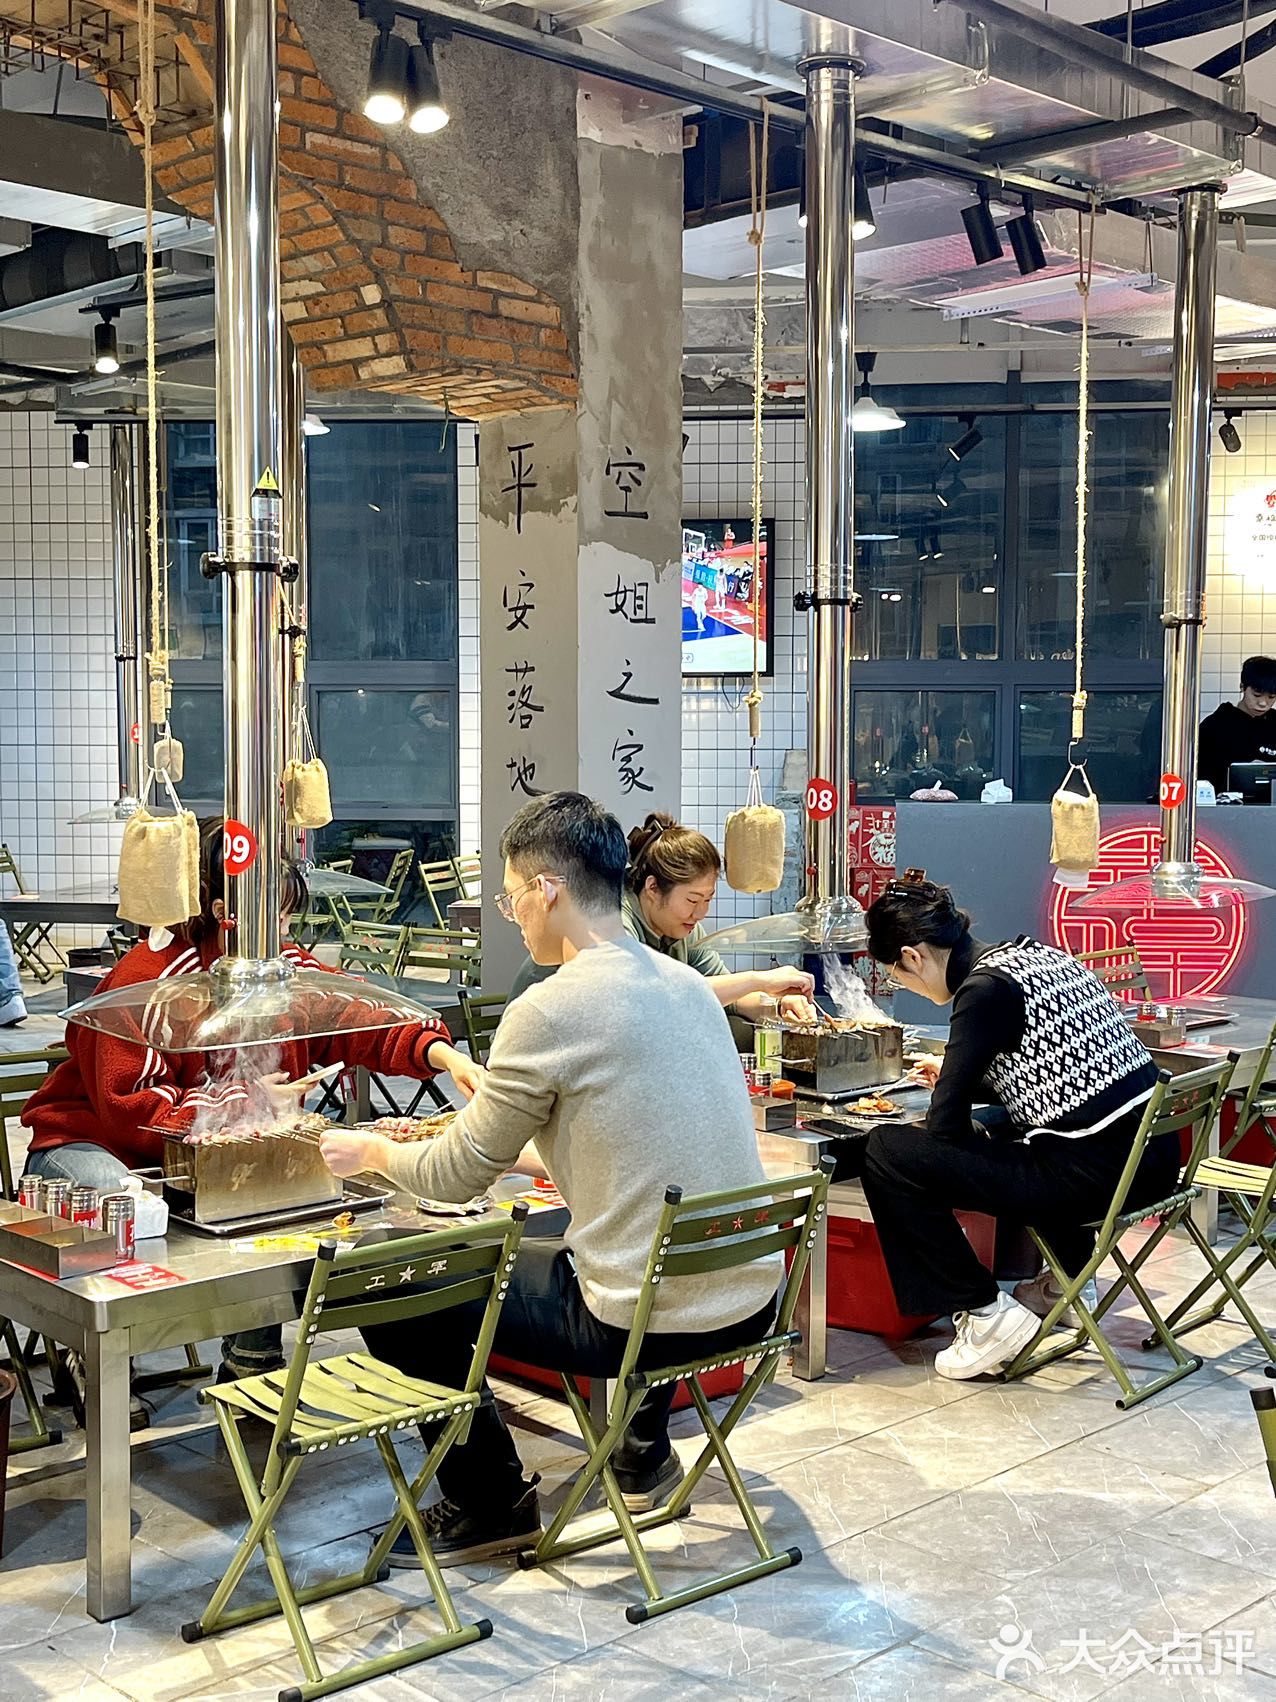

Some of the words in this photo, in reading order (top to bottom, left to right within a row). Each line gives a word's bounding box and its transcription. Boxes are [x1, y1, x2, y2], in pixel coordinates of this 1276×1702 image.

[501, 441, 546, 797] 平安落地
[603, 447, 660, 794] 空姐之家
[807, 787, 833, 812] 08
[1160, 782, 1182, 801] 07
